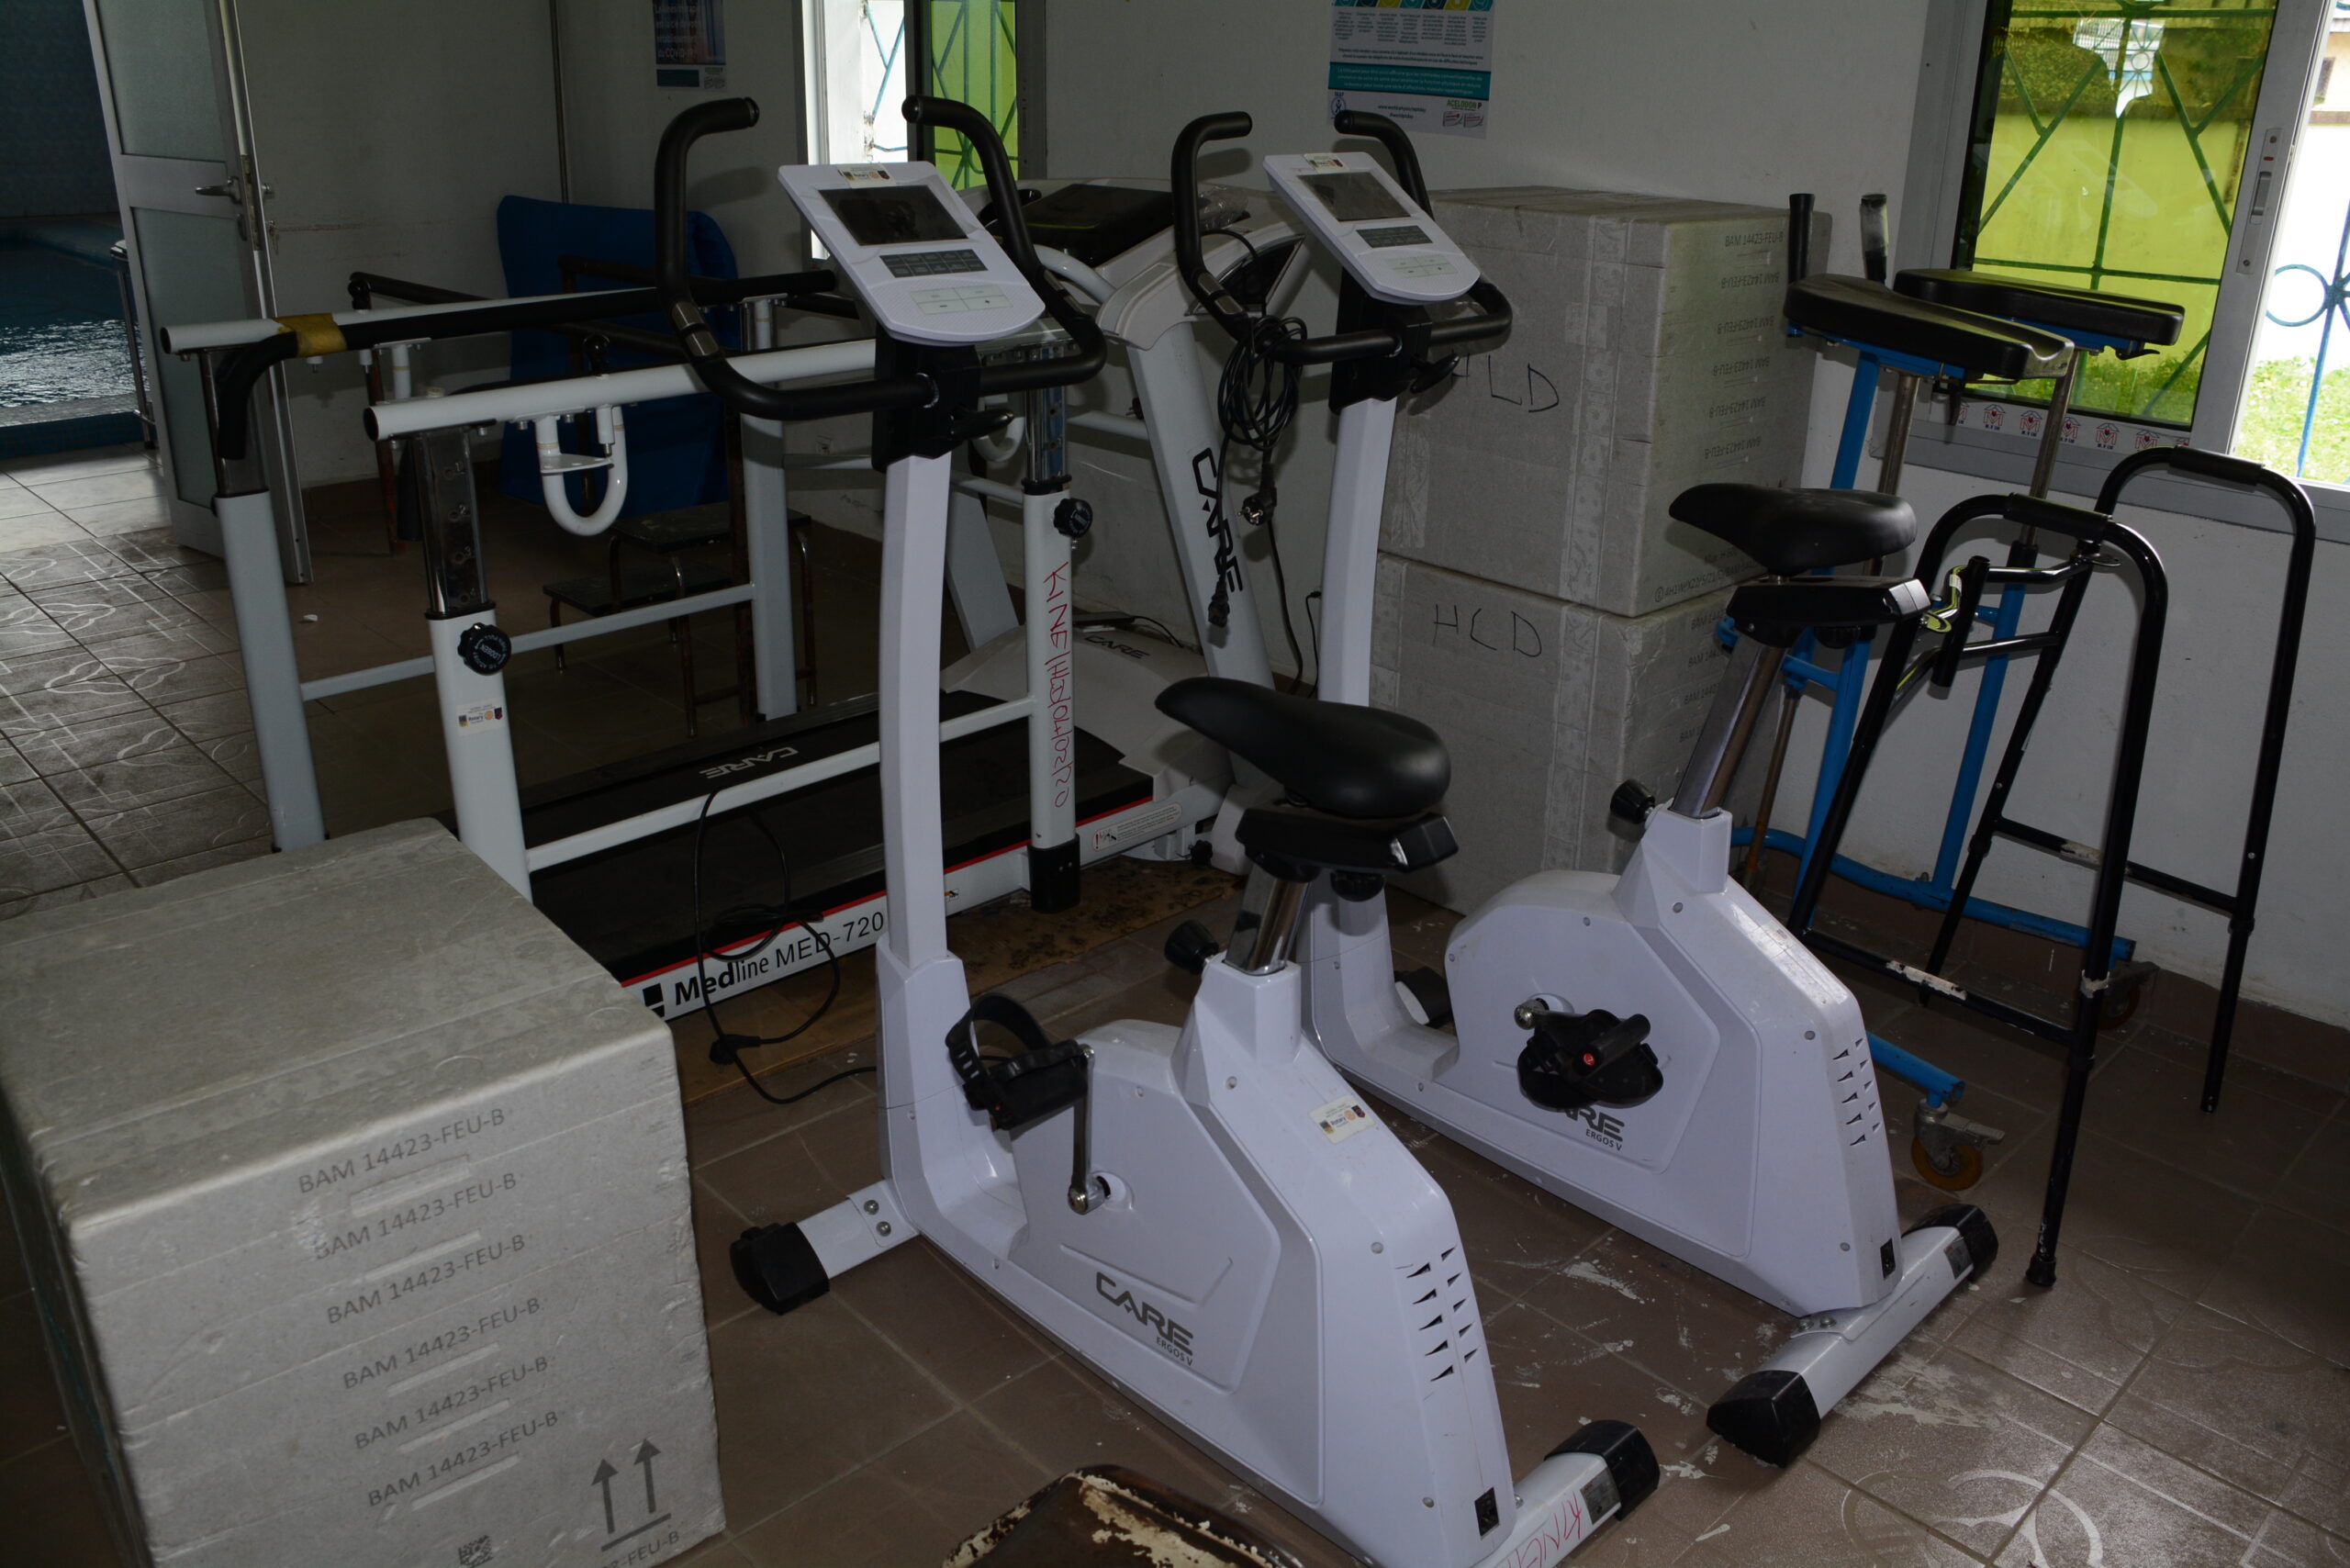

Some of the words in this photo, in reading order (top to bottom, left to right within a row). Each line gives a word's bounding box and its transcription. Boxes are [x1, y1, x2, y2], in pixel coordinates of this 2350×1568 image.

[1084, 635, 1150, 659] CARE
[699, 746, 799, 778] CARE
[674, 957, 768, 1005] Medline
[776, 912, 884, 968] MED-720
[298, 1159, 355, 1193] BAM
[363, 1108, 506, 1172] 14423-FEU-B
[1565, 1103, 1625, 1142] RE
[1585, 1128, 1614, 1148] ERGOS
[1615, 1142, 1623, 1152] V
[316, 1226, 371, 1260] BAM
[377, 1172, 516, 1238] 14423-FEU-B
[327, 1290, 382, 1323] BAM
[388, 1234, 525, 1301] 14423-FEU-B
[1096, 1271, 1193, 1356] CARE
[343, 1355, 397, 1389] BAM
[405, 1297, 541, 1363] 14423-FEU-B
[1157, 1337, 1184, 1361] ERGOS
[1185, 1356, 1193, 1367] V
[353, 1416, 408, 1450] BAM
[415, 1356, 549, 1424] 14423-FEU-B
[367, 1472, 420, 1506] BAM
[427, 1411, 558, 1482] 14423-FEU-B
